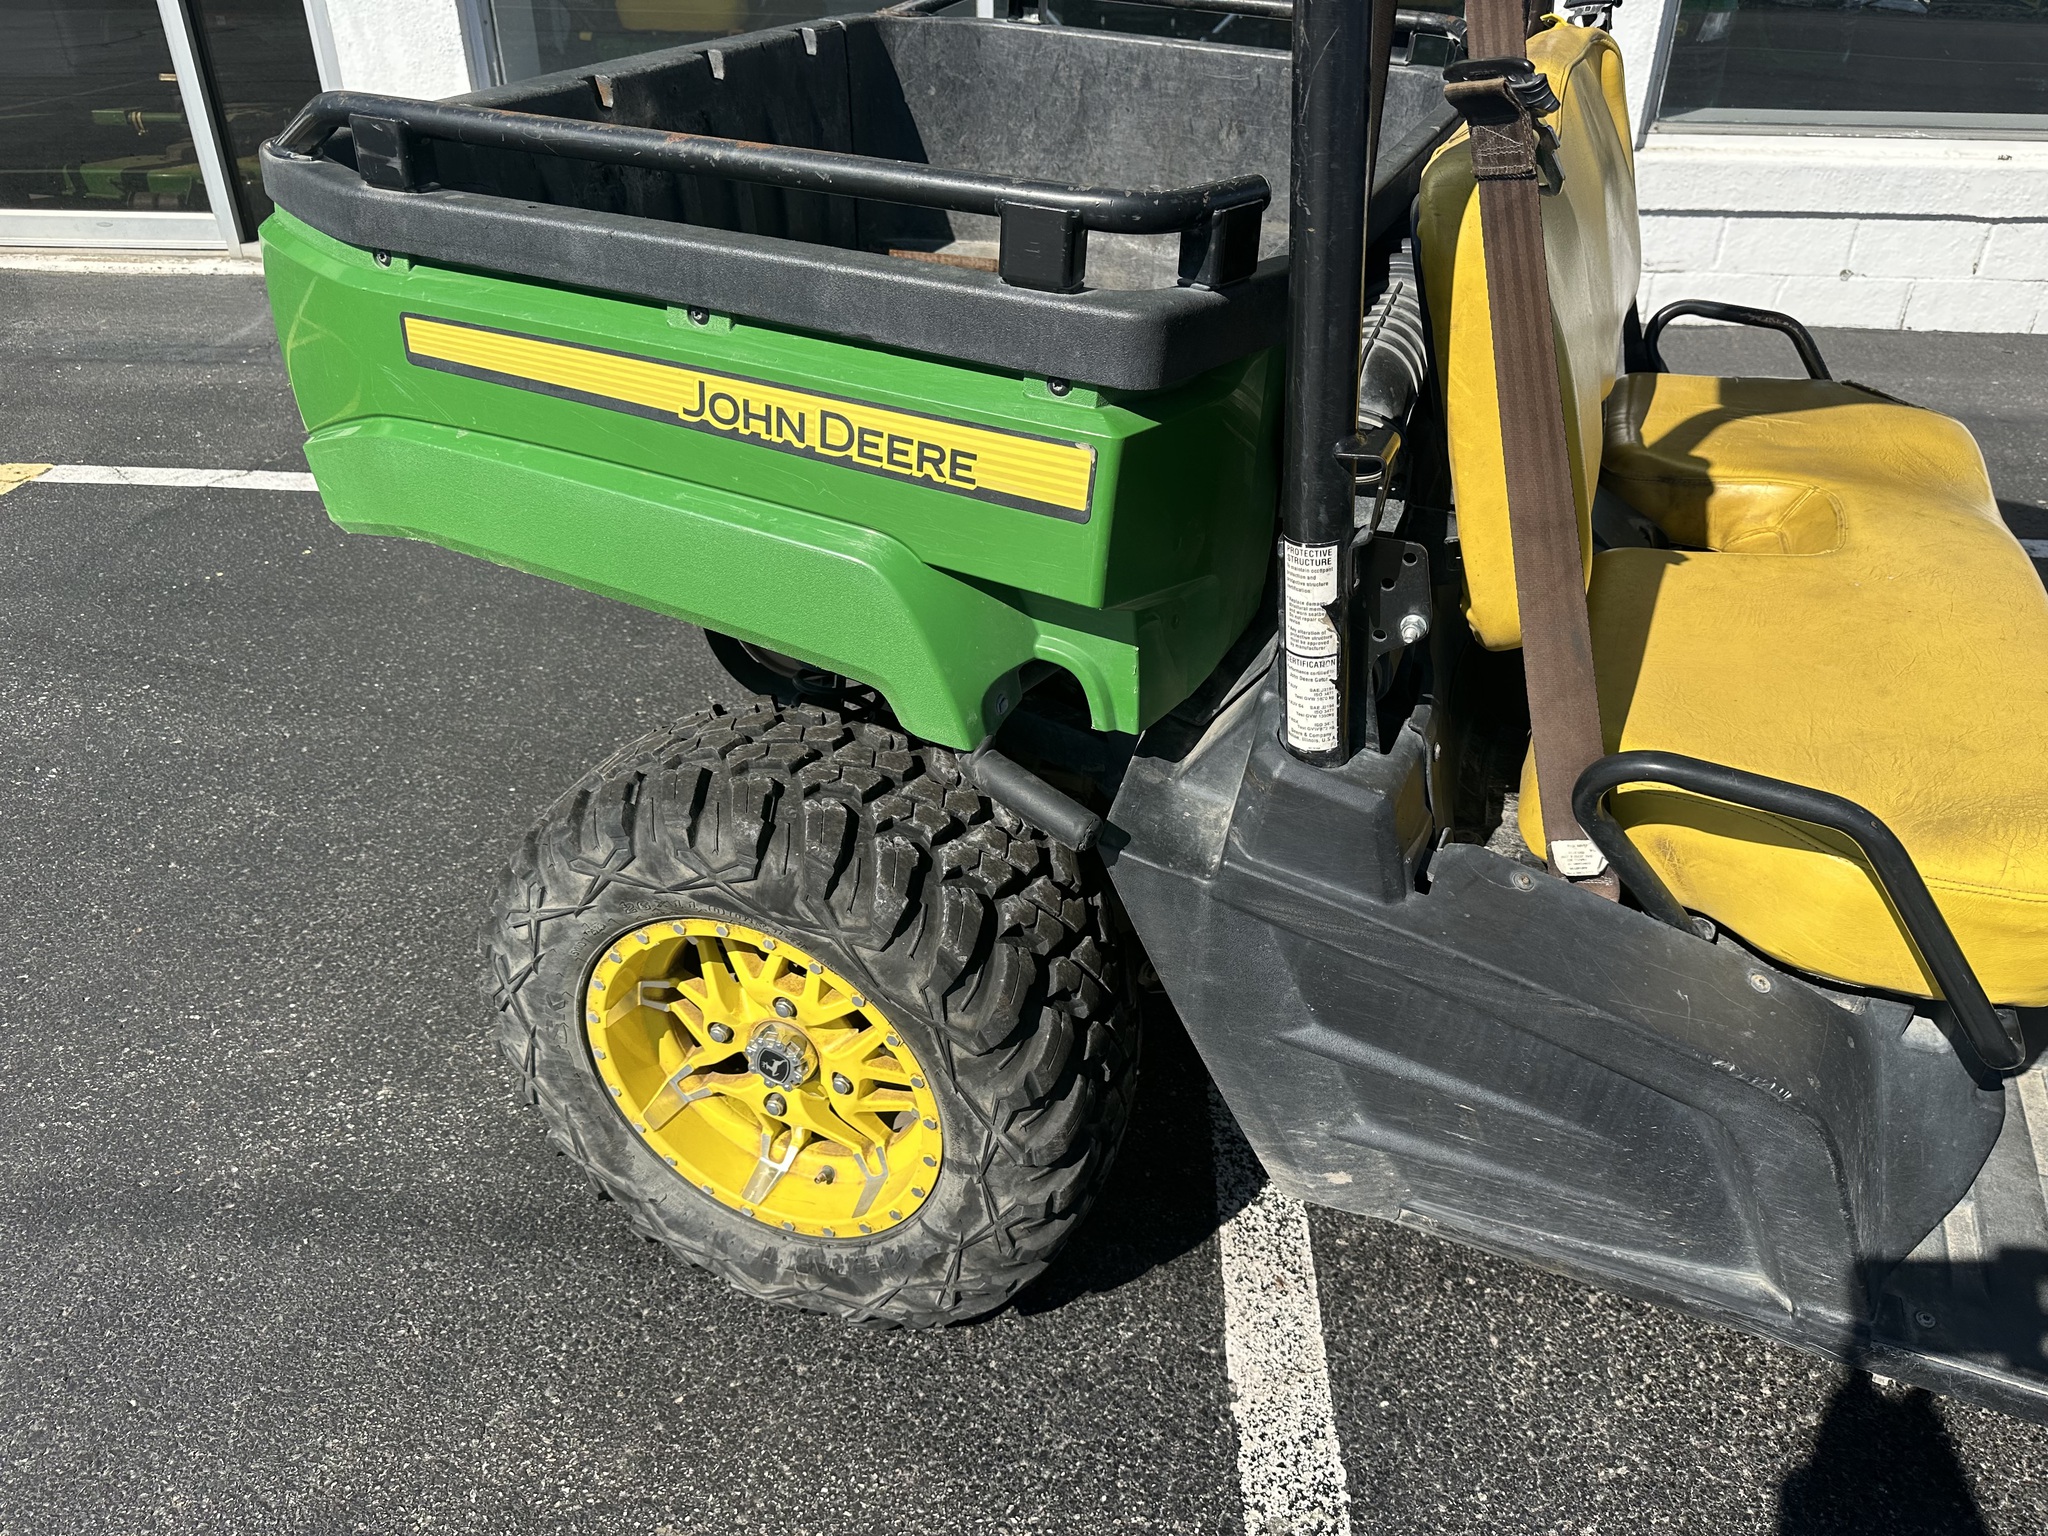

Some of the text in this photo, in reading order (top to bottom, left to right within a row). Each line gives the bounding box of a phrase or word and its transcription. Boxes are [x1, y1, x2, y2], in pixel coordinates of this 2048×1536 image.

[682, 380, 978, 486] JOHN DEERE
[1287, 545, 1332, 557] PROTECTIVE
[1287, 554, 1332, 566] STRUCTURE
